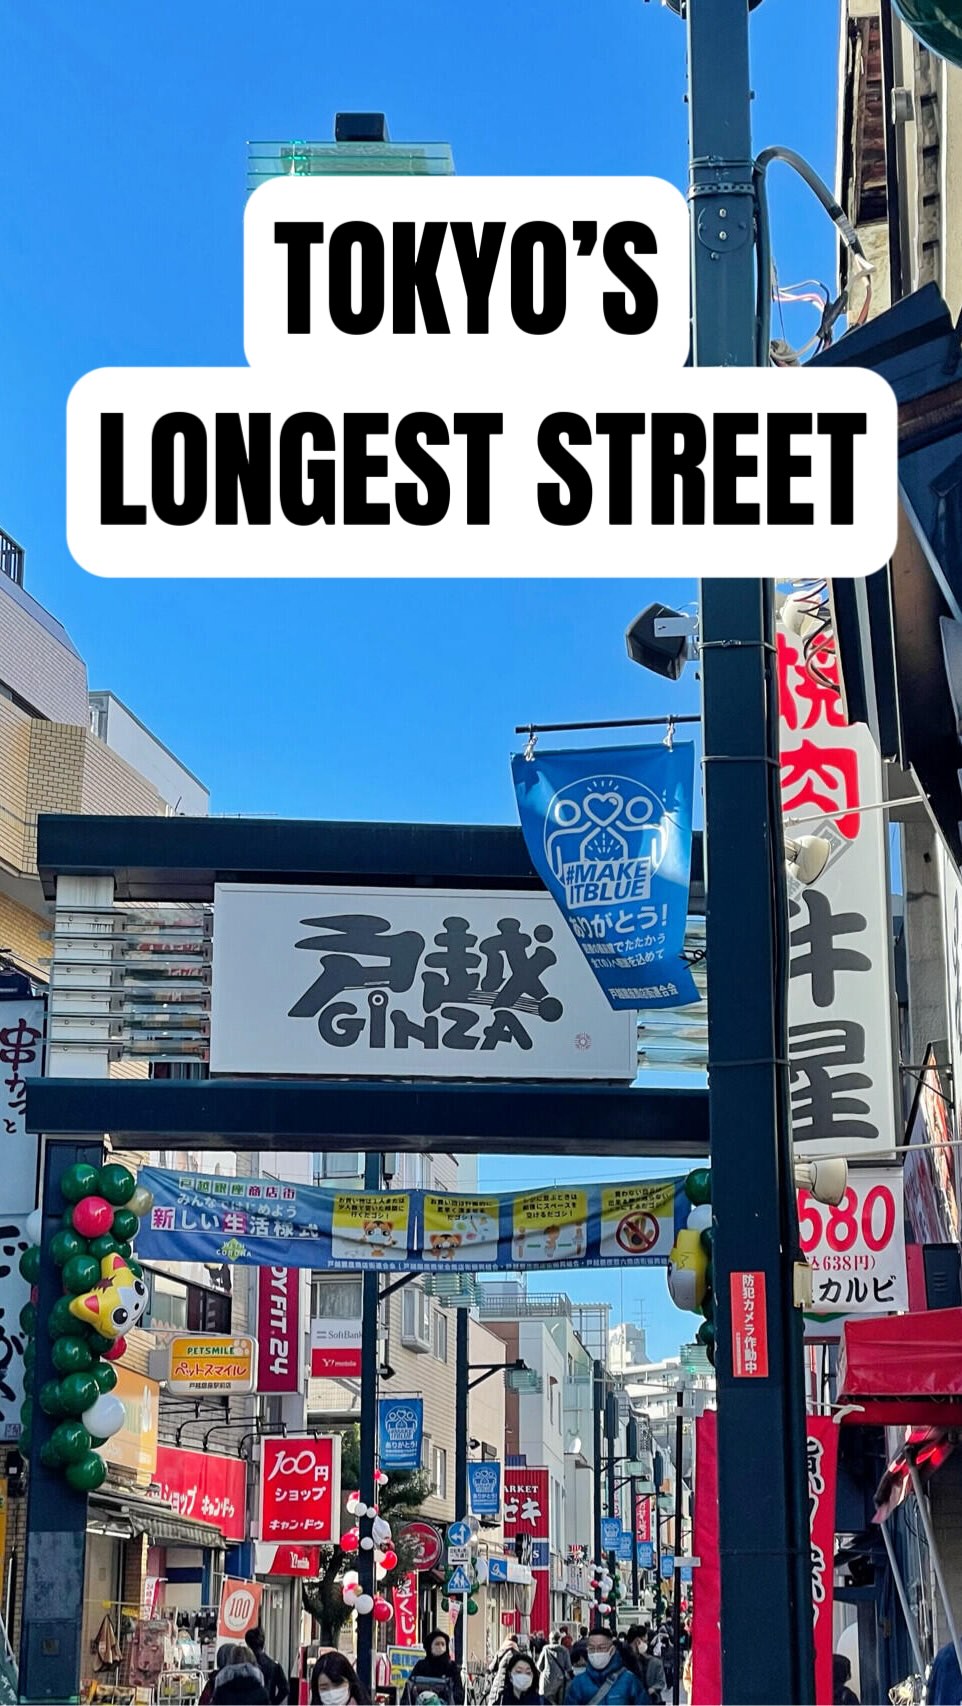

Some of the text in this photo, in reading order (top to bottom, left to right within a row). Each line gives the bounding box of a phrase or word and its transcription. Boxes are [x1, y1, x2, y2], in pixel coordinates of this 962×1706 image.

[566, 859, 647, 886] #MAKE
[287, 913, 564, 1023] 戸越
[152, 1206, 319, 1238] 新しい生活様式
[742, 1273, 758, 1375] 防犯カメラ作動中
[187, 1346, 235, 1355] PETSMILE
[175, 1362, 247, 1377] ペットスマイル
[150, 1482, 198, 1517] ショップ
[275, 1486, 327, 1502] ショップ
[229, 1597, 250, 1620] 100
